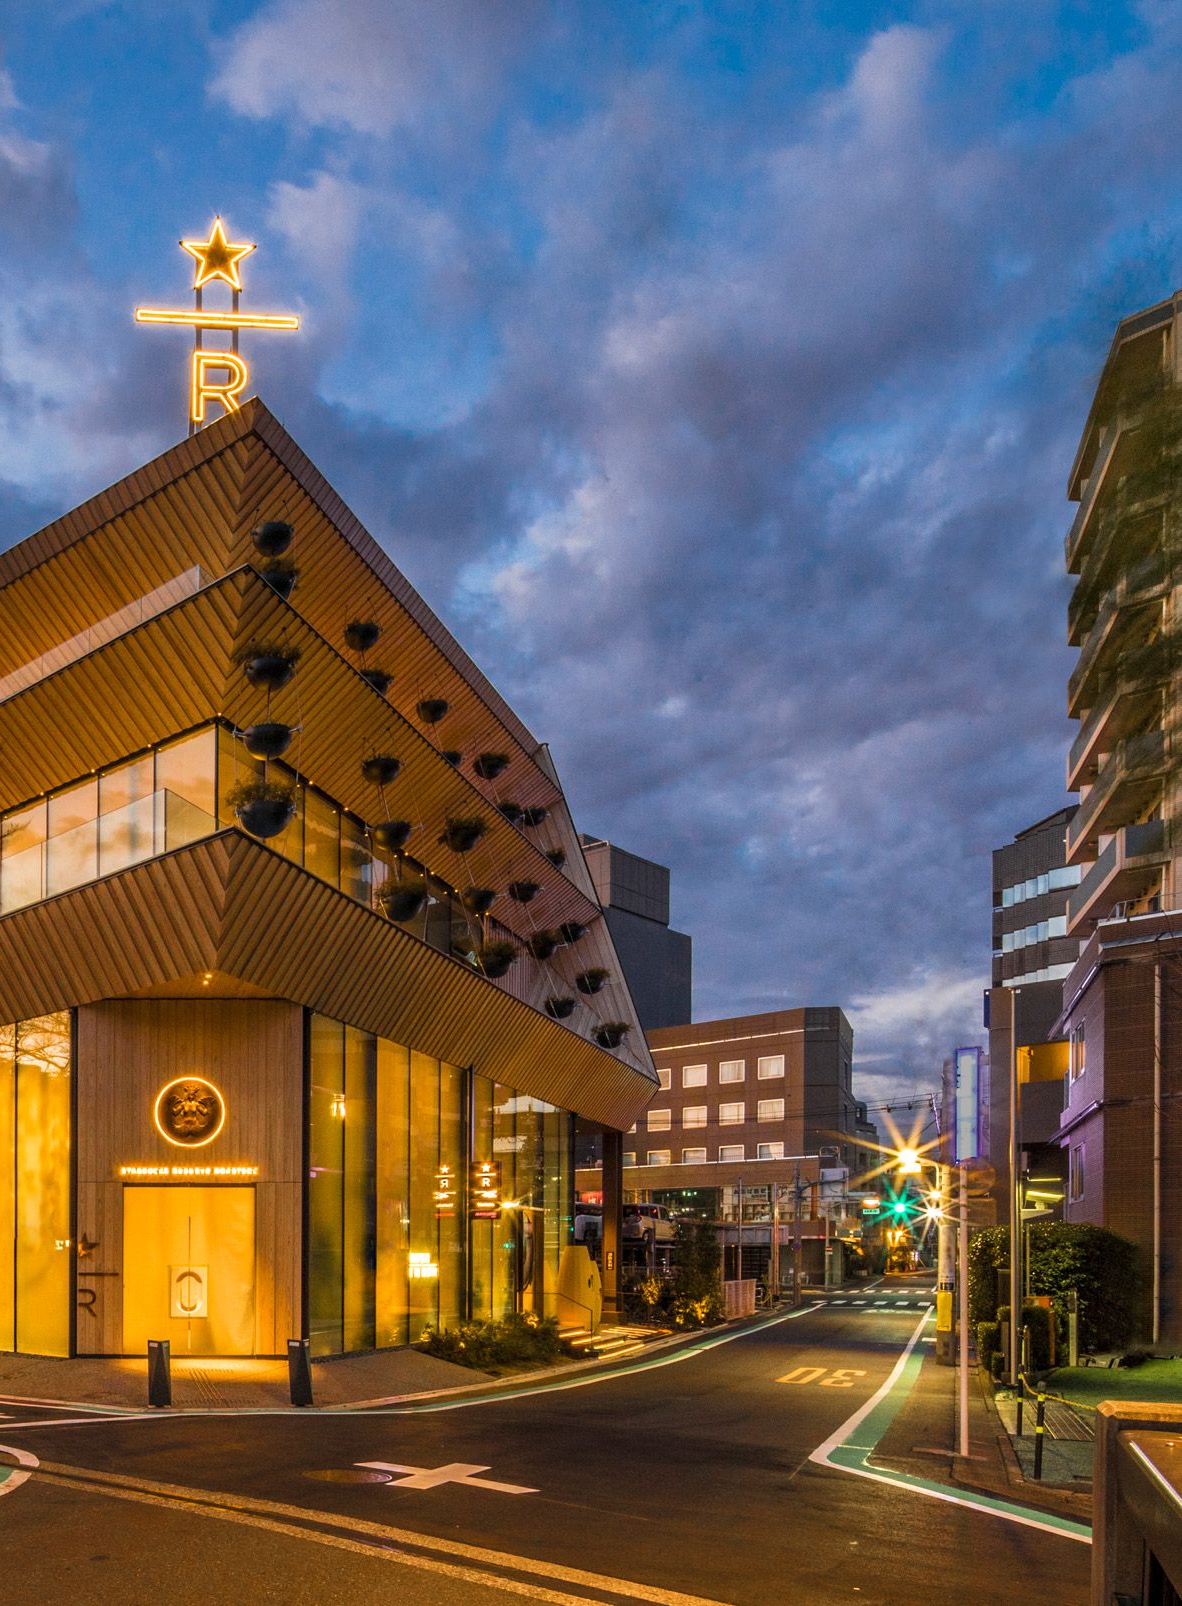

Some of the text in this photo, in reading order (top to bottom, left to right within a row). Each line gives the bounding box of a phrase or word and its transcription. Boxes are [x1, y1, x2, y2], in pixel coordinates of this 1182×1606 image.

[192, 351, 249, 422] R
[482, 1177, 490, 1187] R
[78, 1288, 97, 1318] R
[774, 1367, 866, 1387] 30
